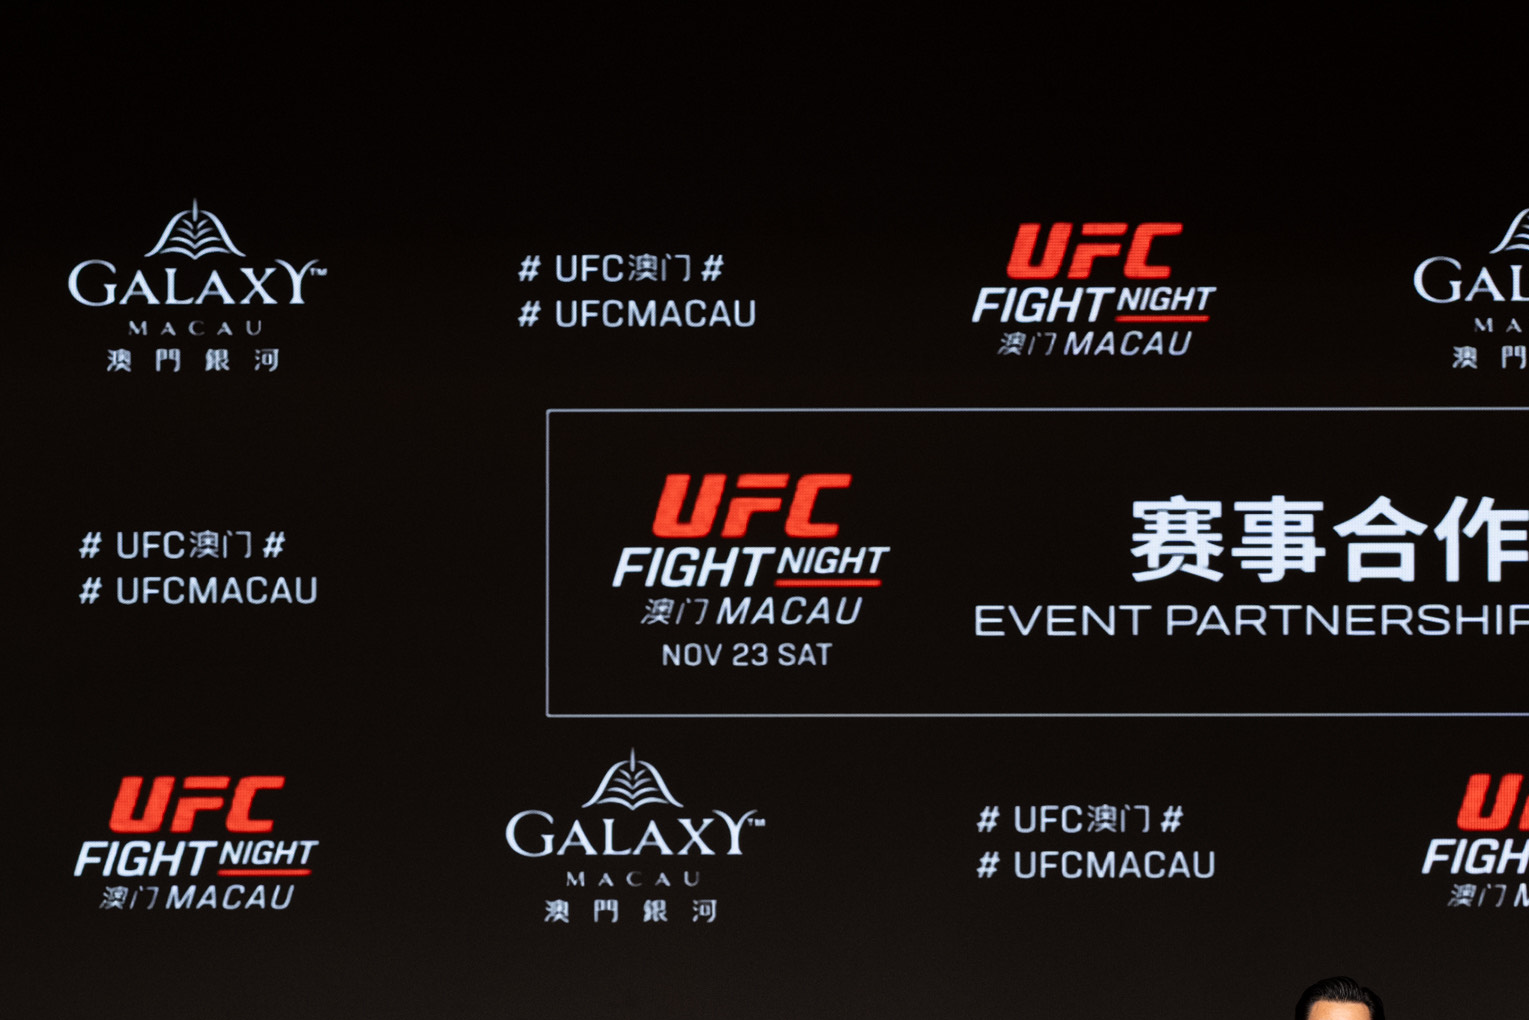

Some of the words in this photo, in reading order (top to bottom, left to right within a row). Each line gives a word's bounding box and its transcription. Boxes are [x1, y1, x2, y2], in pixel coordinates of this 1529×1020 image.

[1006, 222, 1183, 280] UFC
[518, 255, 541, 281] #
[701, 254, 724, 281] #
[518, 300, 541, 327] #
[556, 299, 755, 327] UFCMACAU
[972, 287, 1116, 323] FIGHT
[1117, 286, 1217, 311] NIGHT
[129, 320, 261, 336] MACAU
[998, 332, 1057, 355] 澳门
[1064, 330, 1192, 356] MACAU
[107, 348, 279, 372] 澳門銀河
[652, 473, 853, 538] UFC
[79, 532, 102, 558] #
[263, 531, 286, 558] #
[612, 547, 776, 587] FIGHT
[777, 546, 891, 574] NIGHT
[79, 577, 102, 604] #
[117, 576, 317, 605] UFCMACAU
[641, 598, 709, 624] 澳门
[716, 596, 863, 625] MACAU
[975, 605, 1152, 637] EVENT
[663, 643, 722, 666] NOV
[733, 643, 768, 666] 23
[778, 643, 832, 666] SAT
[109, 775, 286, 834] UFC
[977, 806, 1000, 832] #
[1160, 806, 1184, 832] #
[74, 841, 218, 877] FIGHT
[219, 840, 319, 865] NIGHT
[977, 851, 1000, 878] #
[1015, 851, 1215, 879] UFCMACAU
[567, 871, 698, 887] MACAU
[100, 886, 159, 909] 澳门
[166, 884, 294, 910] MACAU
[1448, 884, 1507, 907] 澳门
[544, 899, 717, 923] 澳門銀河
